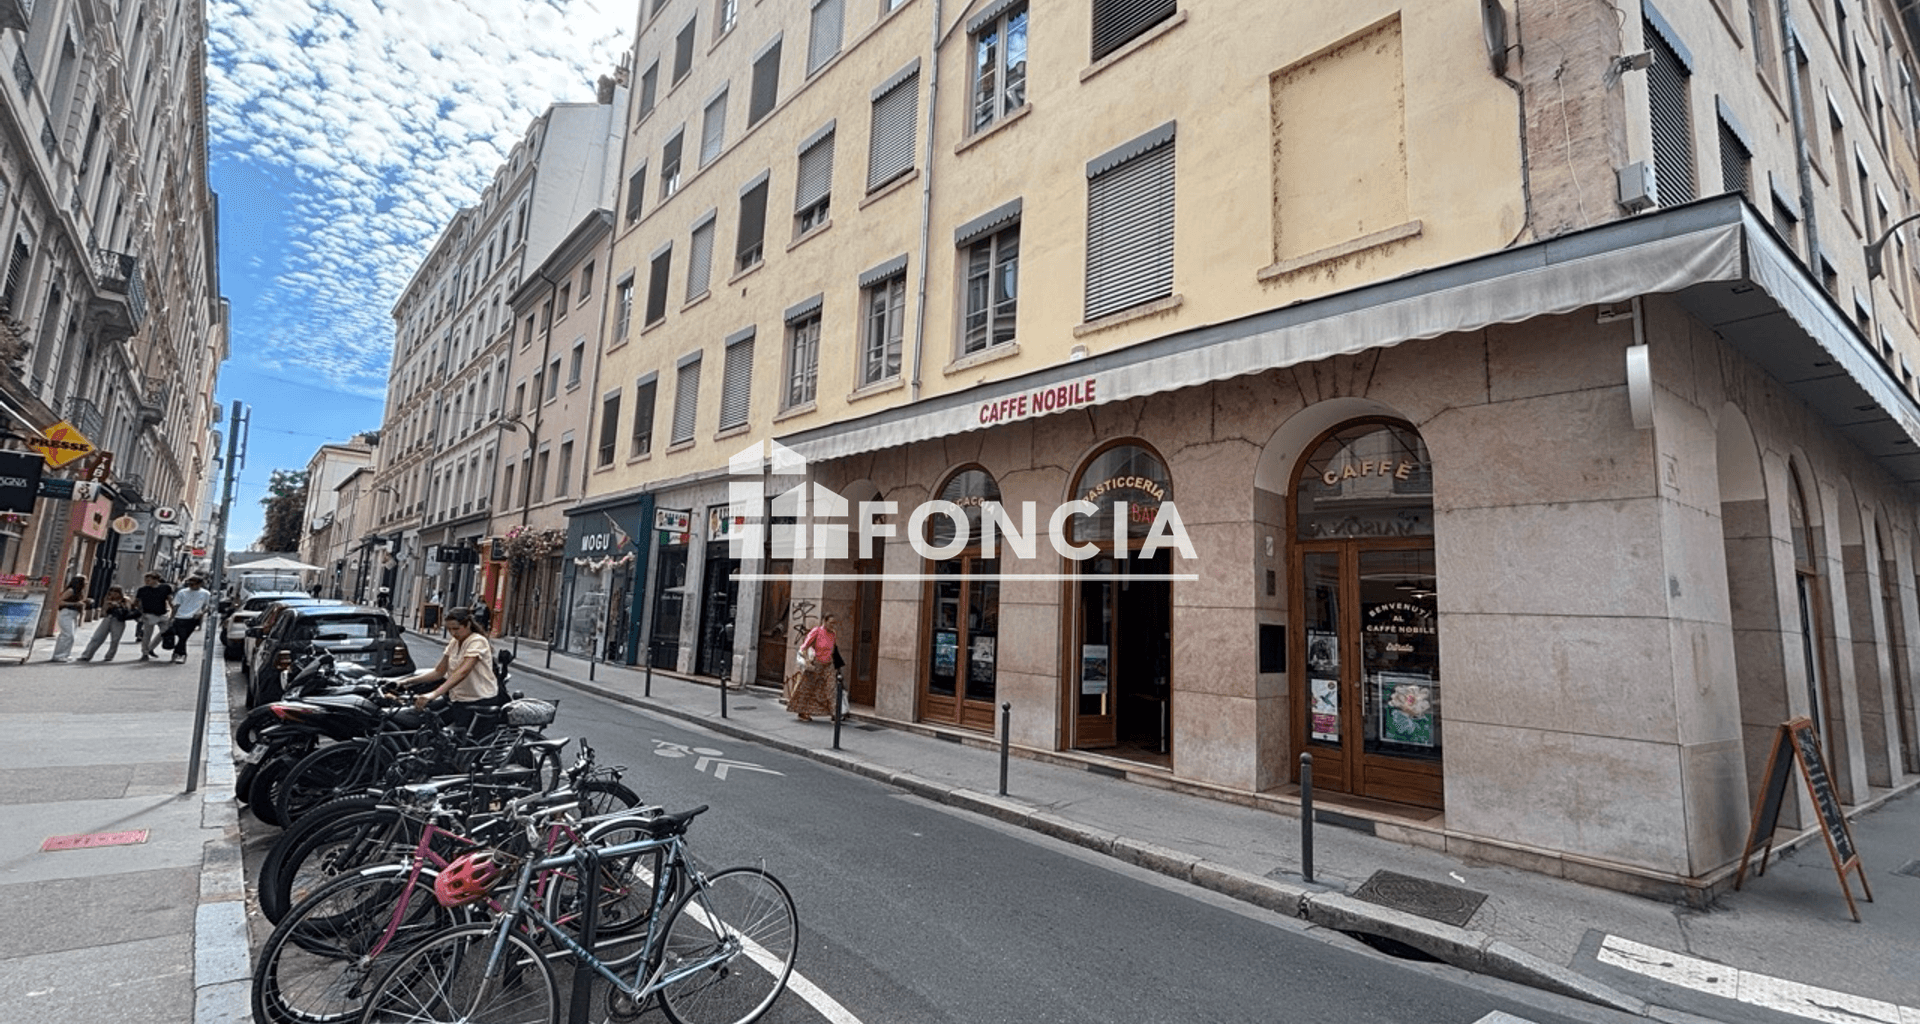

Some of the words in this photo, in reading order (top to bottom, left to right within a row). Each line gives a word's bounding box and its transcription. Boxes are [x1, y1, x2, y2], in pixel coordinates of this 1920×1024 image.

[979, 394, 1027, 424] CAFFE
[1032, 379, 1097, 413] NOBILE
[29, 437, 89, 452] PRESSE
[1323, 460, 1413, 486] CAFFÈ
[1081, 476, 1165, 507] PASTICCERIA
[581, 533, 610, 551] MOGU
[1368, 602, 1431, 618] BENVENUTI
[1398, 625, 1436, 634] NOBILE
